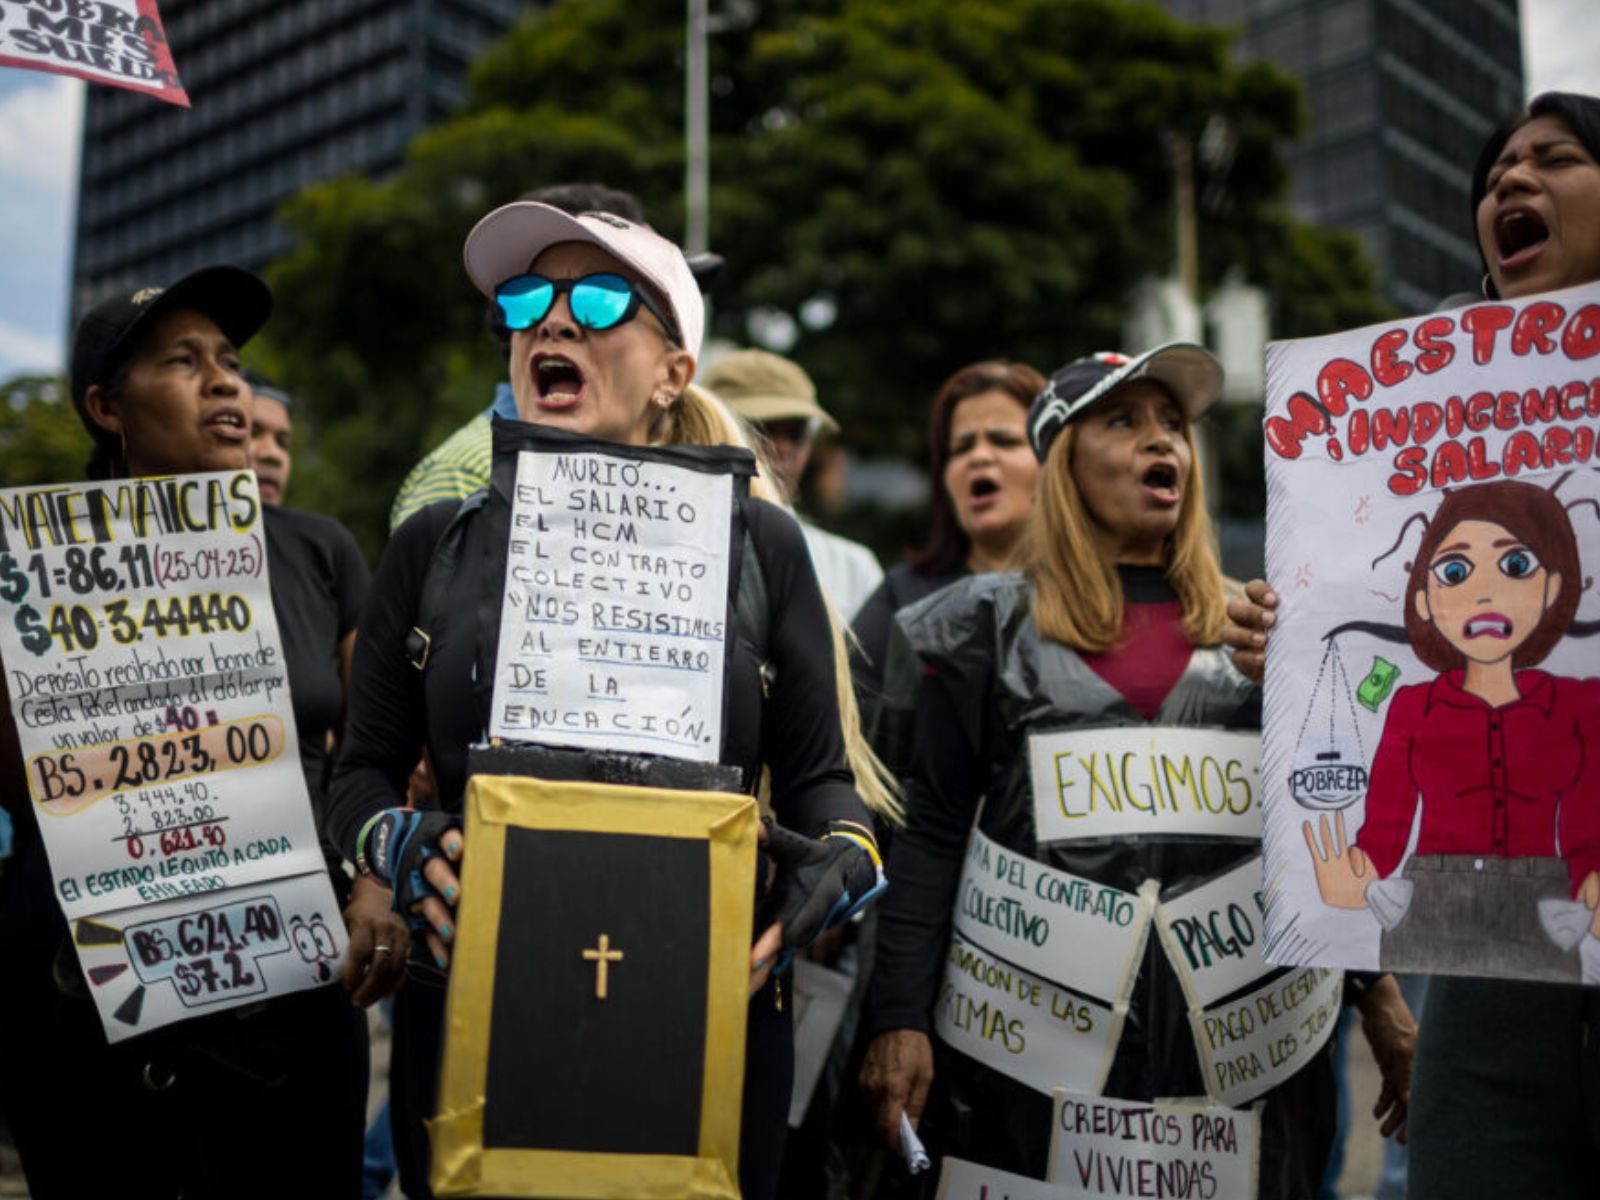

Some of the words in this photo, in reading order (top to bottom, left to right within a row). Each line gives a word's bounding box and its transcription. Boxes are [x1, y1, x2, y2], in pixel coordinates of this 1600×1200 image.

[28, 8, 158, 63] MES
[553, 456, 676, 492] MURIÓ...
[1387, 425, 1600, 496] SALARI
[516, 514, 549, 532] EL
[574, 517, 637, 544] HCM
[518, 484, 553, 505] EL
[567, 489, 696, 523] SALARIO
[153, 534, 263, 589] (25-04-25)
[511, 540, 549, 558] EL
[571, 547, 706, 579] CONTRATO
[512, 566, 692, 602] COLECTIVO
[592, 602, 723, 636] RESISTIMOS
[521, 632, 551, 653] AL
[578, 639, 709, 669] ENTIERRO
[509, 663, 546, 688] DE
[590, 674, 618, 694] LA
[504, 705, 711, 743] EDUCACIÓN.
[1292, 767, 1367, 794] POBREZA
[86, 866, 154, 896] ESTADO
[233, 848, 246, 866] A
[246, 835, 292, 861] CADA
[997, 853, 1027, 890] DEL
[1036, 872, 1134, 926] CONTRATO
[962, 878, 1049, 947] COLECTIVO
[1170, 903, 1254, 970] PAGO
[175, 952, 254, 996] $7.2
[1018, 977, 1042, 1007] DE
[1051, 991, 1093, 1033] LAS
[1204, 1006, 1255, 1050] PAGO
[1256, 991, 1283, 1026] DE
[1215, 1052, 1265, 1090] PARA
[1267, 1034, 1297, 1068] LOS
[1061, 1100, 1181, 1146] CREDITOS
[1192, 1113, 1238, 1155] PARA
[1074, 1149, 1217, 1200] VIVIENDAS
